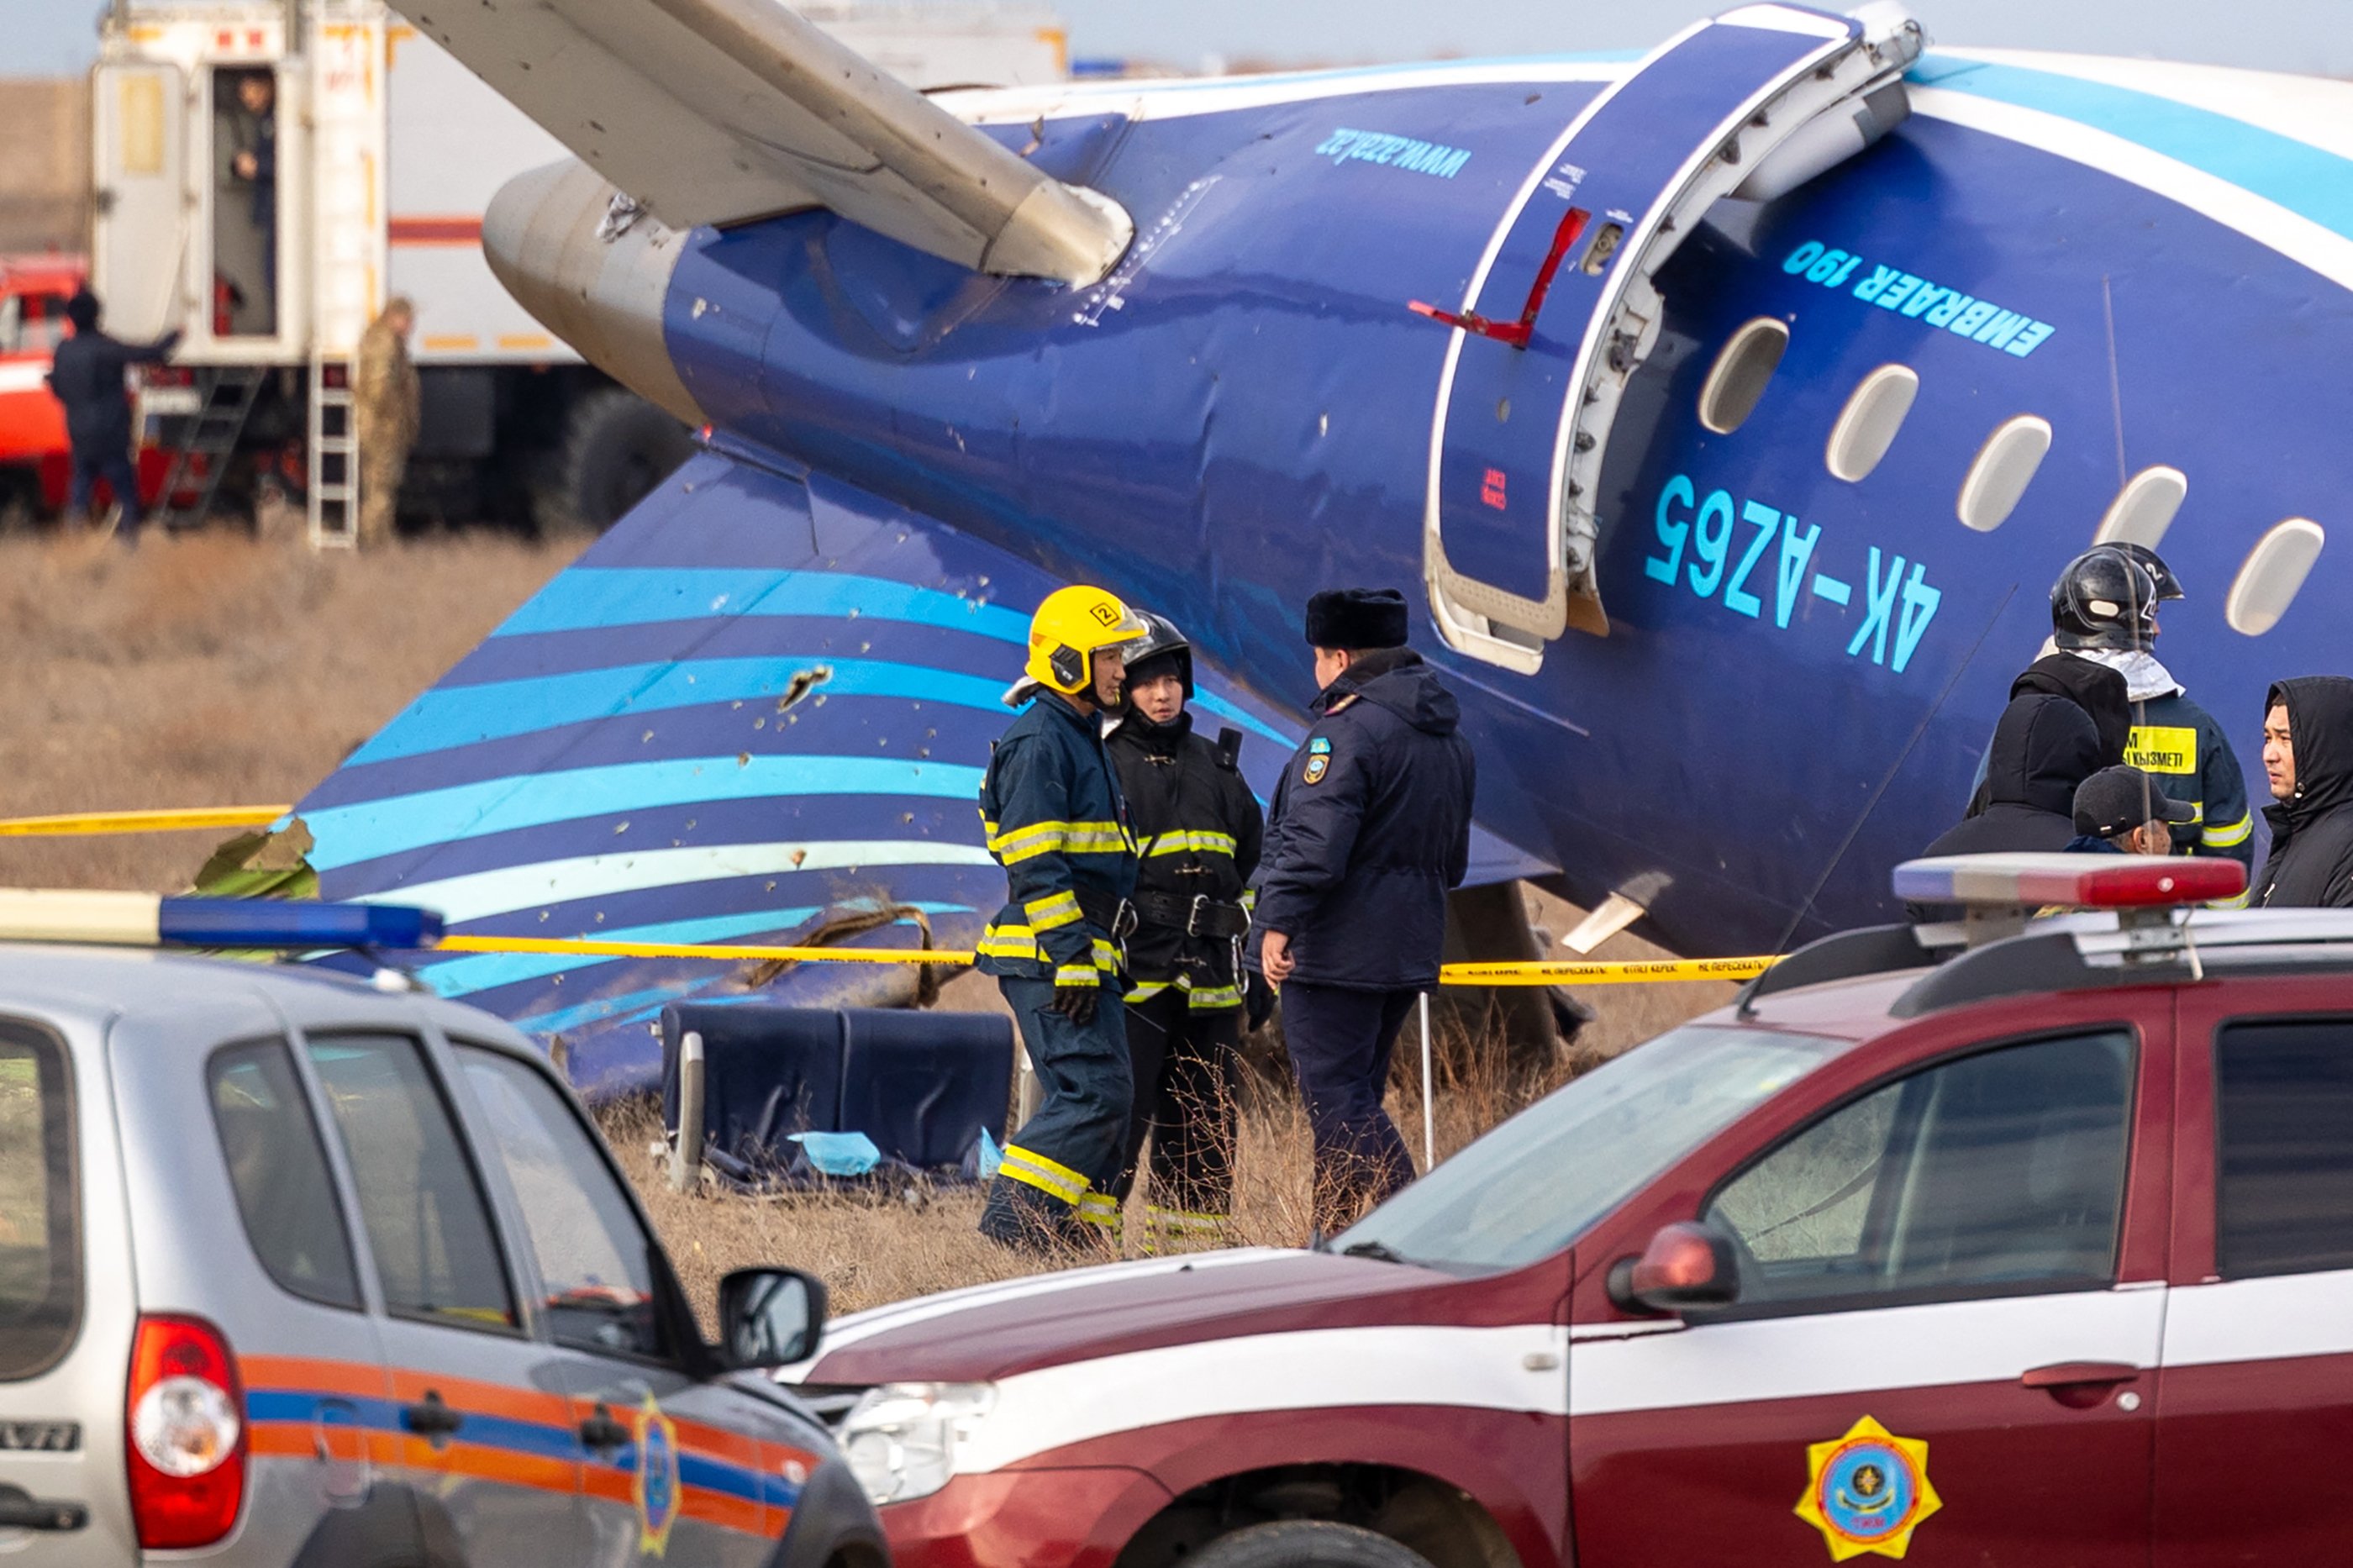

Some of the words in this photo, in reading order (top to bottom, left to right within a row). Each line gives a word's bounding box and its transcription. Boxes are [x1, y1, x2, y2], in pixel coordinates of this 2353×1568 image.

[1783, 240, 1863, 287] 190
[1853, 264, 2056, 358] EMBRAER
[1645, 474, 1940, 673] 4K-AZ65
[2145, 562, 2164, 581] 2
[1098, 608, 1112, 619] 2
